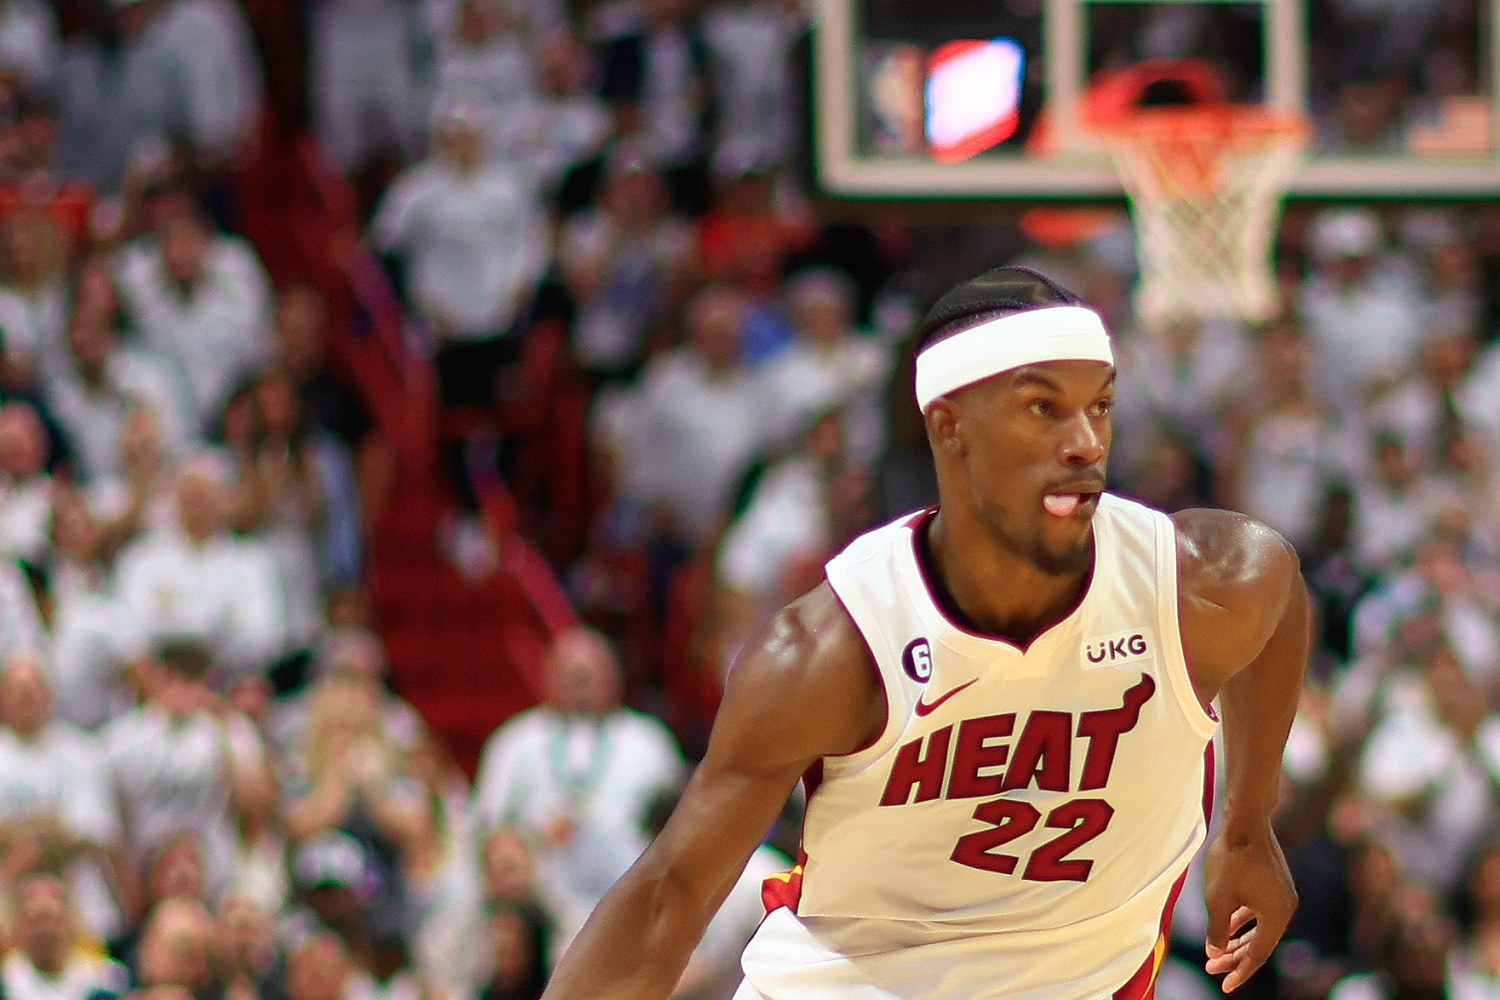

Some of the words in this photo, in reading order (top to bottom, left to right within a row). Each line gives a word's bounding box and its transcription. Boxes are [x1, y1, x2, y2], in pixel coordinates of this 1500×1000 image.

[911, 643, 931, 678] 6
[878, 672, 1156, 807] HEAT
[949, 798, 1115, 883] 22
